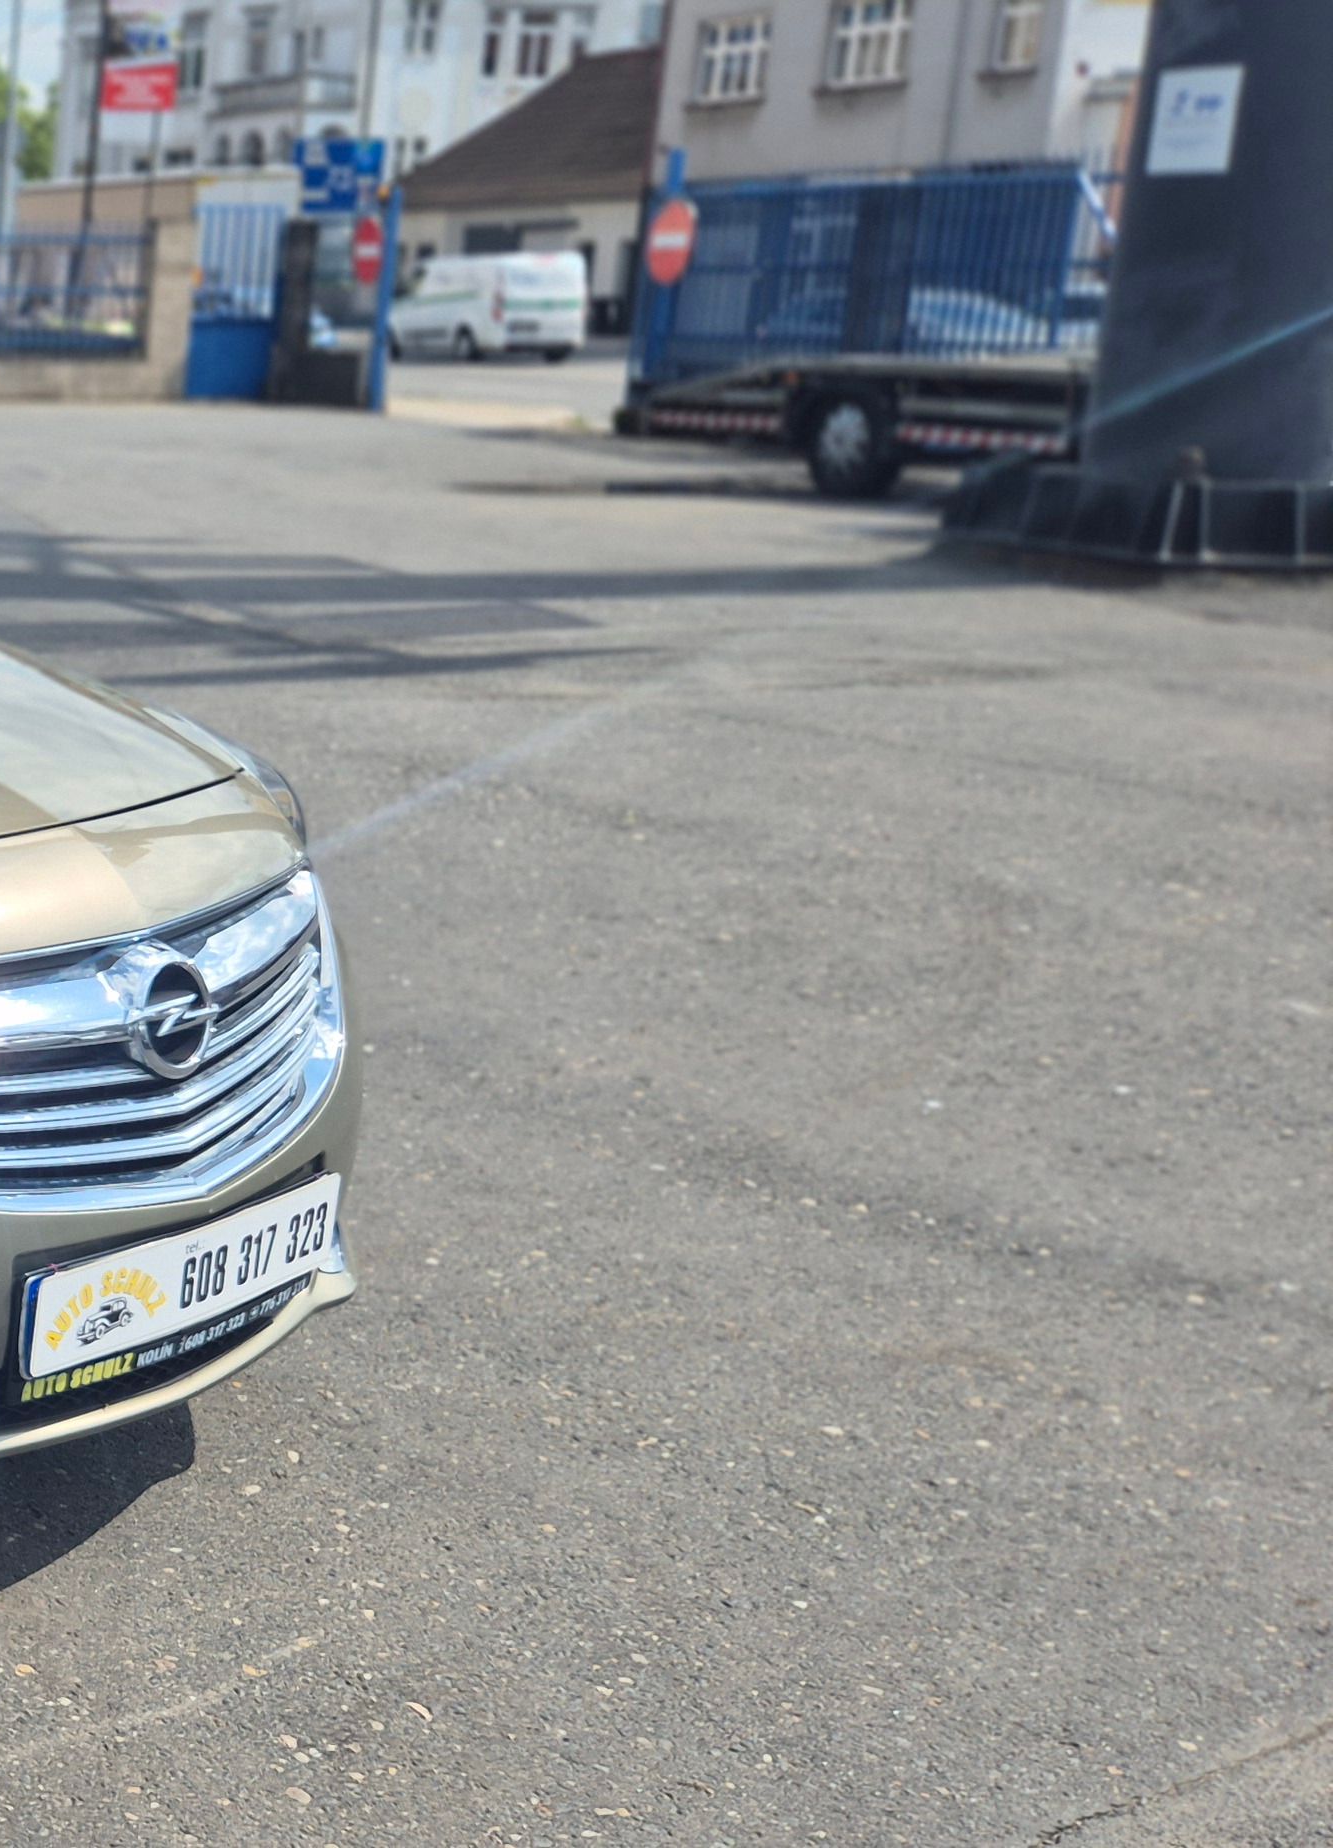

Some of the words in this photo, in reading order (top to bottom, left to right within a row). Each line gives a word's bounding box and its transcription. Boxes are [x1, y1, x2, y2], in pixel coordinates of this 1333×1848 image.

[179, 1245, 229, 1309] 608
[237, 1223, 278, 1285] 317
[285, 1201, 328, 1264] 323
[44, 1283, 94, 1351] AUTO
[100, 1267, 169, 1318] SCHULZ
[21, 1372, 67, 1402] AUTO
[70, 1352, 135, 1388] SCHULZ
[136, 1341, 174, 1368] KOLÍN
